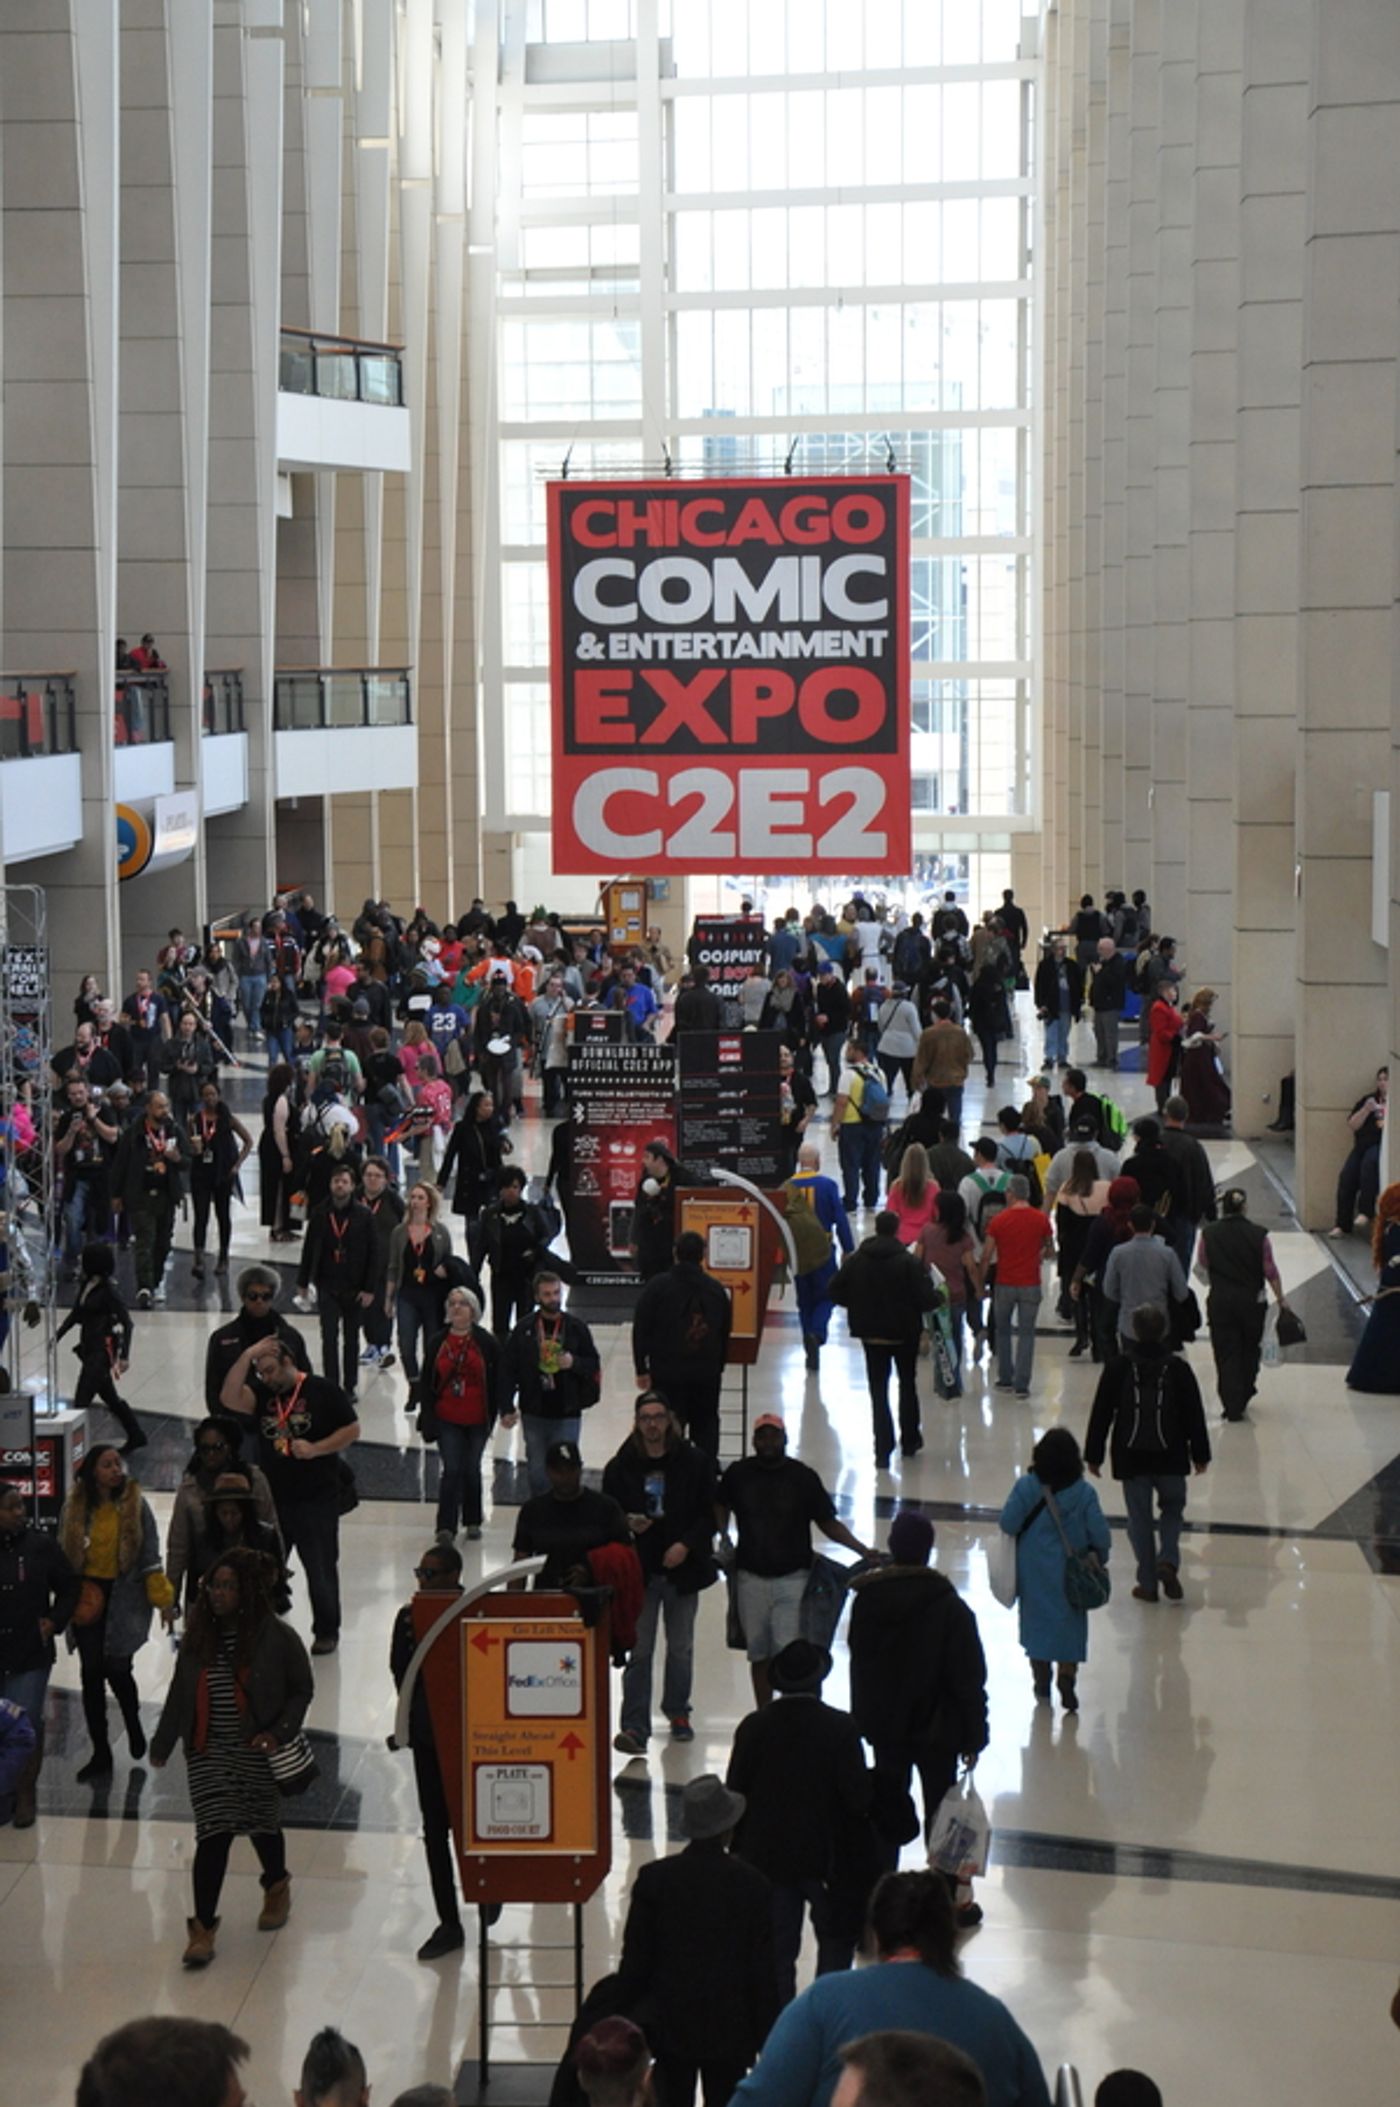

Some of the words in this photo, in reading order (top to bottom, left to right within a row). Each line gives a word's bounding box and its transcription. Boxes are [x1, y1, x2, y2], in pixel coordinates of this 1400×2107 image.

[570, 494, 886, 549] CHICAGO
[573, 553, 889, 626] COMIC
[576, 632, 606, 660] &
[609, 629, 889, 660] ENTERTAINMENT
[574, 665, 887, 745] EXPO
[572, 766, 888, 860] C2E2
[698, 949, 762, 963] COSPLAY
[432, 1012, 456, 1031] 23
[581, 1047, 639, 1059] DOWNLOAD
[641, 1048, 662, 1059] THE
[571, 1059, 619, 1071] OFFICIAL
[652, 1060, 673, 1072] APP
[512, 1624, 529, 1635] Go
[532, 1624, 555, 1635] Left
[472, 1731, 518, 1743] Straight
[521, 1731, 555, 1741] Ahead
[475, 1746, 500, 1756] This
[502, 1746, 532, 1756] Level
[496, 1769, 530, 1779] PLATE
